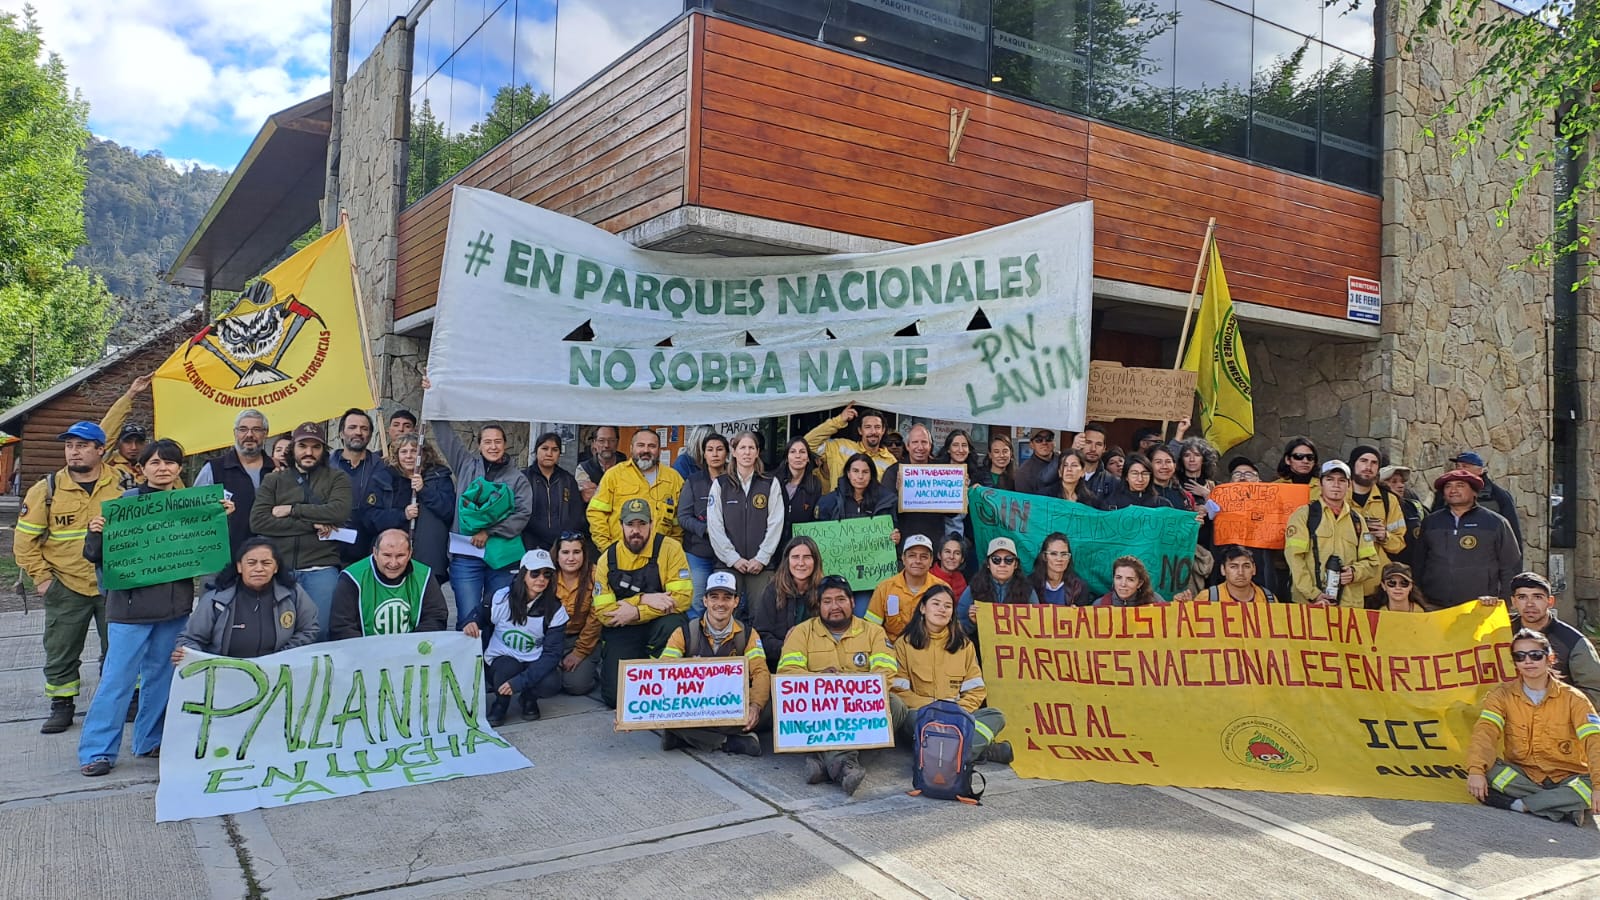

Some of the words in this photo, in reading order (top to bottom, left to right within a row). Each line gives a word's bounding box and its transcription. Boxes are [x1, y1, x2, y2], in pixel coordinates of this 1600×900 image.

[504, 239, 565, 295] EN
[573, 258, 766, 319] PARQUES
[777, 252, 1042, 315] NACIONALES
[184, 360, 216, 400] INCENDIOS
[214, 384, 299, 409] COMUNICACIONES
[297, 330, 332, 388] EMERGENCIAS
[568, 345, 637, 392] NO
[648, 350, 788, 394] SOBRA
[798, 347, 929, 393] NADIE
[904, 468, 919, 477] SIN
[904, 479, 916, 489] NO
[916, 479, 932, 489] HAY
[932, 478, 964, 489] PARQUES
[137, 493, 152, 502] EN
[914, 489, 961, 498] NACIONALES
[107, 500, 164, 526] PARQUES
[165, 492, 218, 512] NACIONALES
[974, 487, 1031, 534] SIN
[107, 527, 144, 541] HACEMOS
[155, 534, 166, 544] LA
[197, 542, 223, 553] SOMOS
[119, 571, 136, 580] SUS
[1158, 553, 1192, 592] NO
[992, 600, 1215, 639] BRIGADISTAS
[1221, 600, 1262, 639] EN
[626, 667, 653, 682] SIN
[658, 664, 744, 681] TRABAJADORES
[995, 645, 1135, 687] PARQUES
[1138, 648, 1343, 689] NACIONALES
[1344, 653, 1384, 692] EN
[1388, 642, 1519, 692] RIESGO
[638, 682, 663, 696] NO
[676, 680, 705, 695] HAY
[780, 679, 809, 695] SIN
[813, 678, 882, 695] PARQUES
[782, 698, 808, 713] NO
[811, 697, 840, 712] HAY
[834, 716, 888, 731] DESPIDO
[1086, 704, 1127, 738] AL
[806, 733, 822, 745] EN
[826, 732, 856, 743] APN
[1358, 718, 1448, 751] ICE
[203, 760, 309, 794] EN
[326, 728, 512, 778] LUCHA
